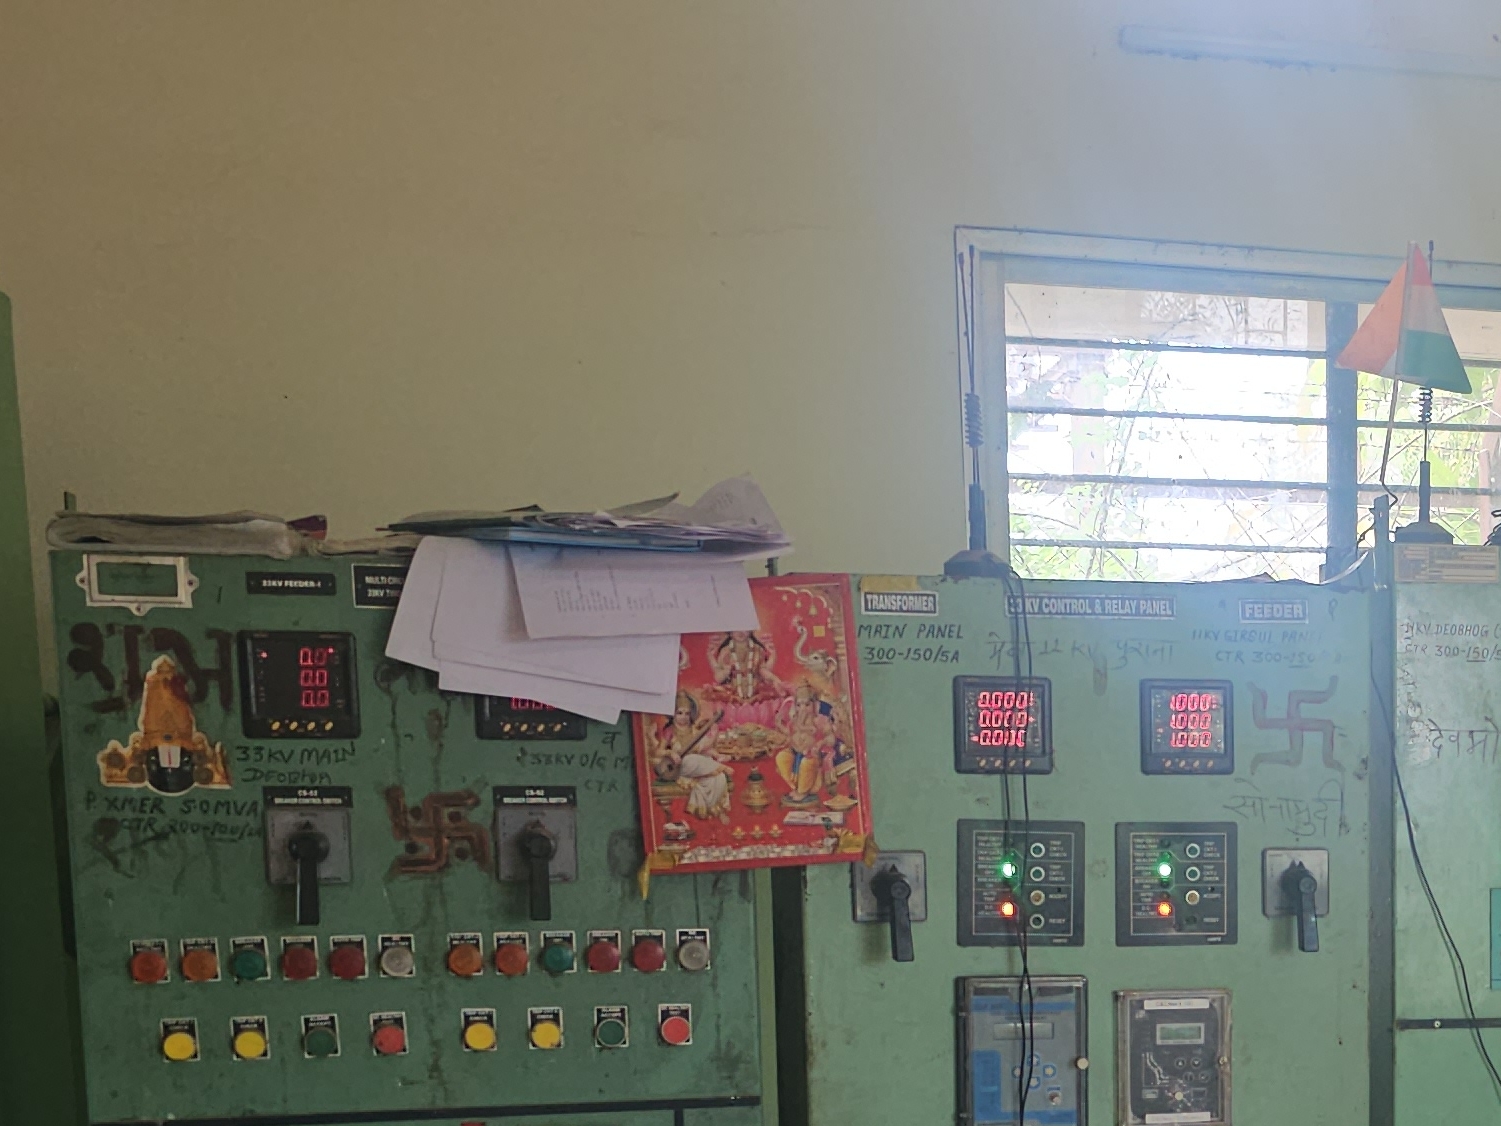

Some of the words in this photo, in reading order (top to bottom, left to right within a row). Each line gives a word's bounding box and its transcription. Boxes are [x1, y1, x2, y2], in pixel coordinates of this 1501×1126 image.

[867, 594, 935, 612] TRANSFORMER
[1026, 597, 1040, 614] KV
[1041, 597, 1092, 615] CONTROL
[1094, 599, 1102, 613] &
[1104, 600, 1138, 615] RELAY
[1139, 600, 1173, 616] PANEL
[1245, 603, 1304, 619] FEEDER
[857, 624, 906, 640] MAIN
[917, 624, 964, 640] PANEL
[864, 645, 960, 665] 300-150/5A
[1215, 650, 1245, 664] CTR
[235, 745, 295, 764] 33KV
[299, 741, 356, 766] MAIN
